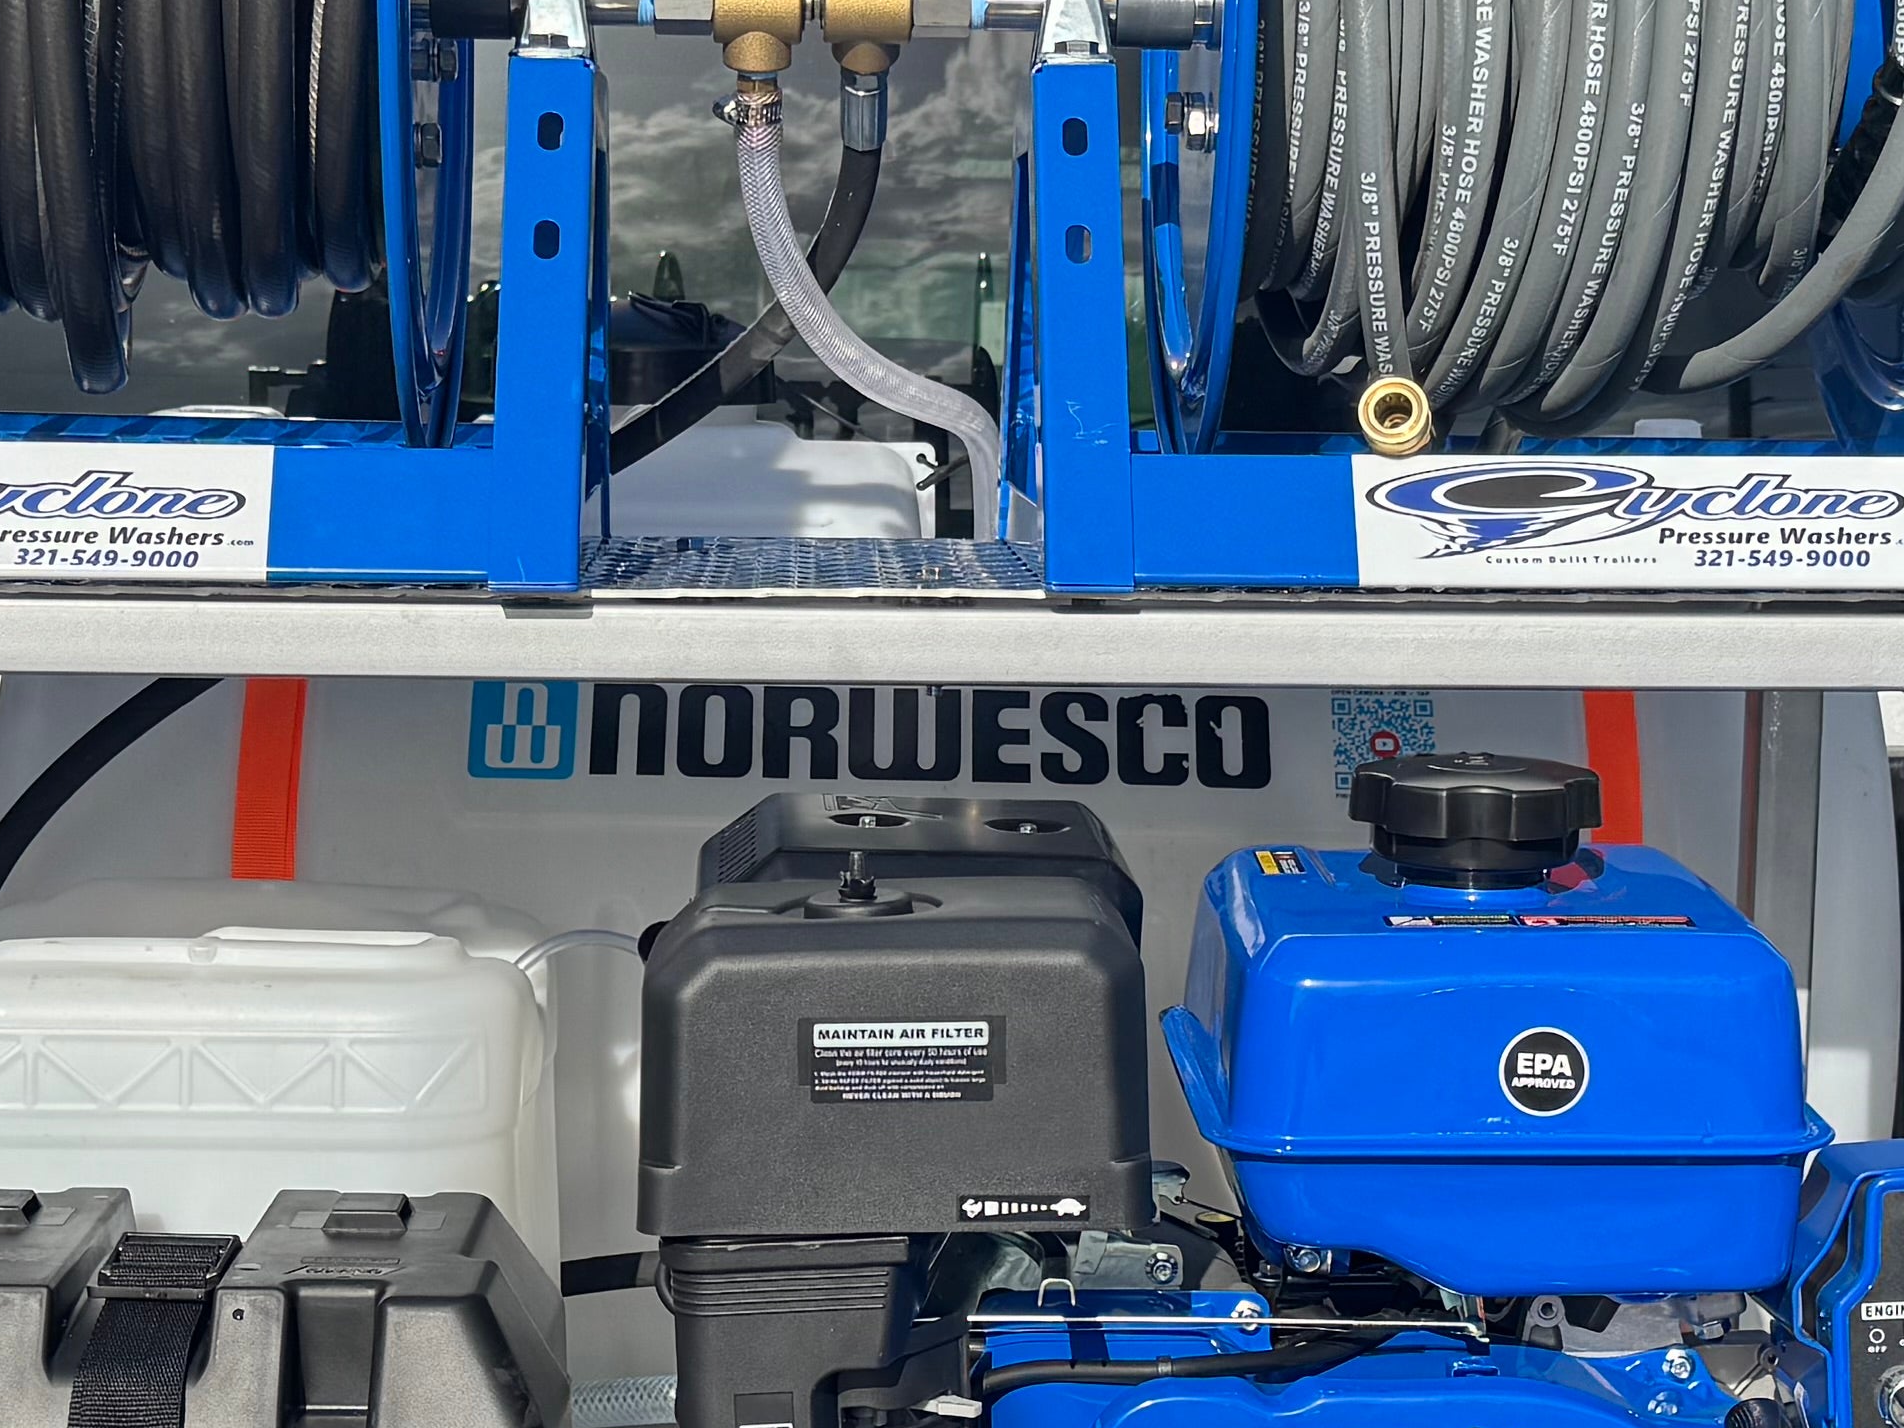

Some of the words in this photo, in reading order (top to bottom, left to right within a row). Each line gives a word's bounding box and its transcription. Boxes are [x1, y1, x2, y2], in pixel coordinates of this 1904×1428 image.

[1466, 27, 1492, 133] WASHER
[1584, 26, 1606, 95] HOSE
[1568, 99, 1597, 194] 4800PSI
[1627, 102, 1645, 148] 3/8"
[1361, 172, 1379, 215] 3/8"
[1455, 138, 1482, 204] HOSE
[1699, 126, 1735, 229] WASHER
[1552, 197, 1578, 257] 275°F
[1591, 155, 1637, 275] PRESSURE
[1434, 206, 1467, 287] 4800PSI
[1497, 236, 1520, 277] 3/8"
[1678, 232, 1709, 289] HOSE
[1364, 222, 1388, 332] PRESSURE
[1457, 279, 1507, 367] PRESSURE
[13, 548, 199, 569] 321-549-9000
[1485, 555, 1544, 564] Custom
[1659, 527, 1770, 546] Pressure
[1693, 549, 1871, 568] 321-549-9000
[590, 682, 1271, 790] NORWESCO
[818, 1029, 894, 1040] MAINTAIN
[899, 1028, 926, 1040] AIR
[931, 1027, 984, 1039] FILTER
[1511, 1077, 1576, 1090] APPROVED
[1517, 1052, 1572, 1077] EPA
